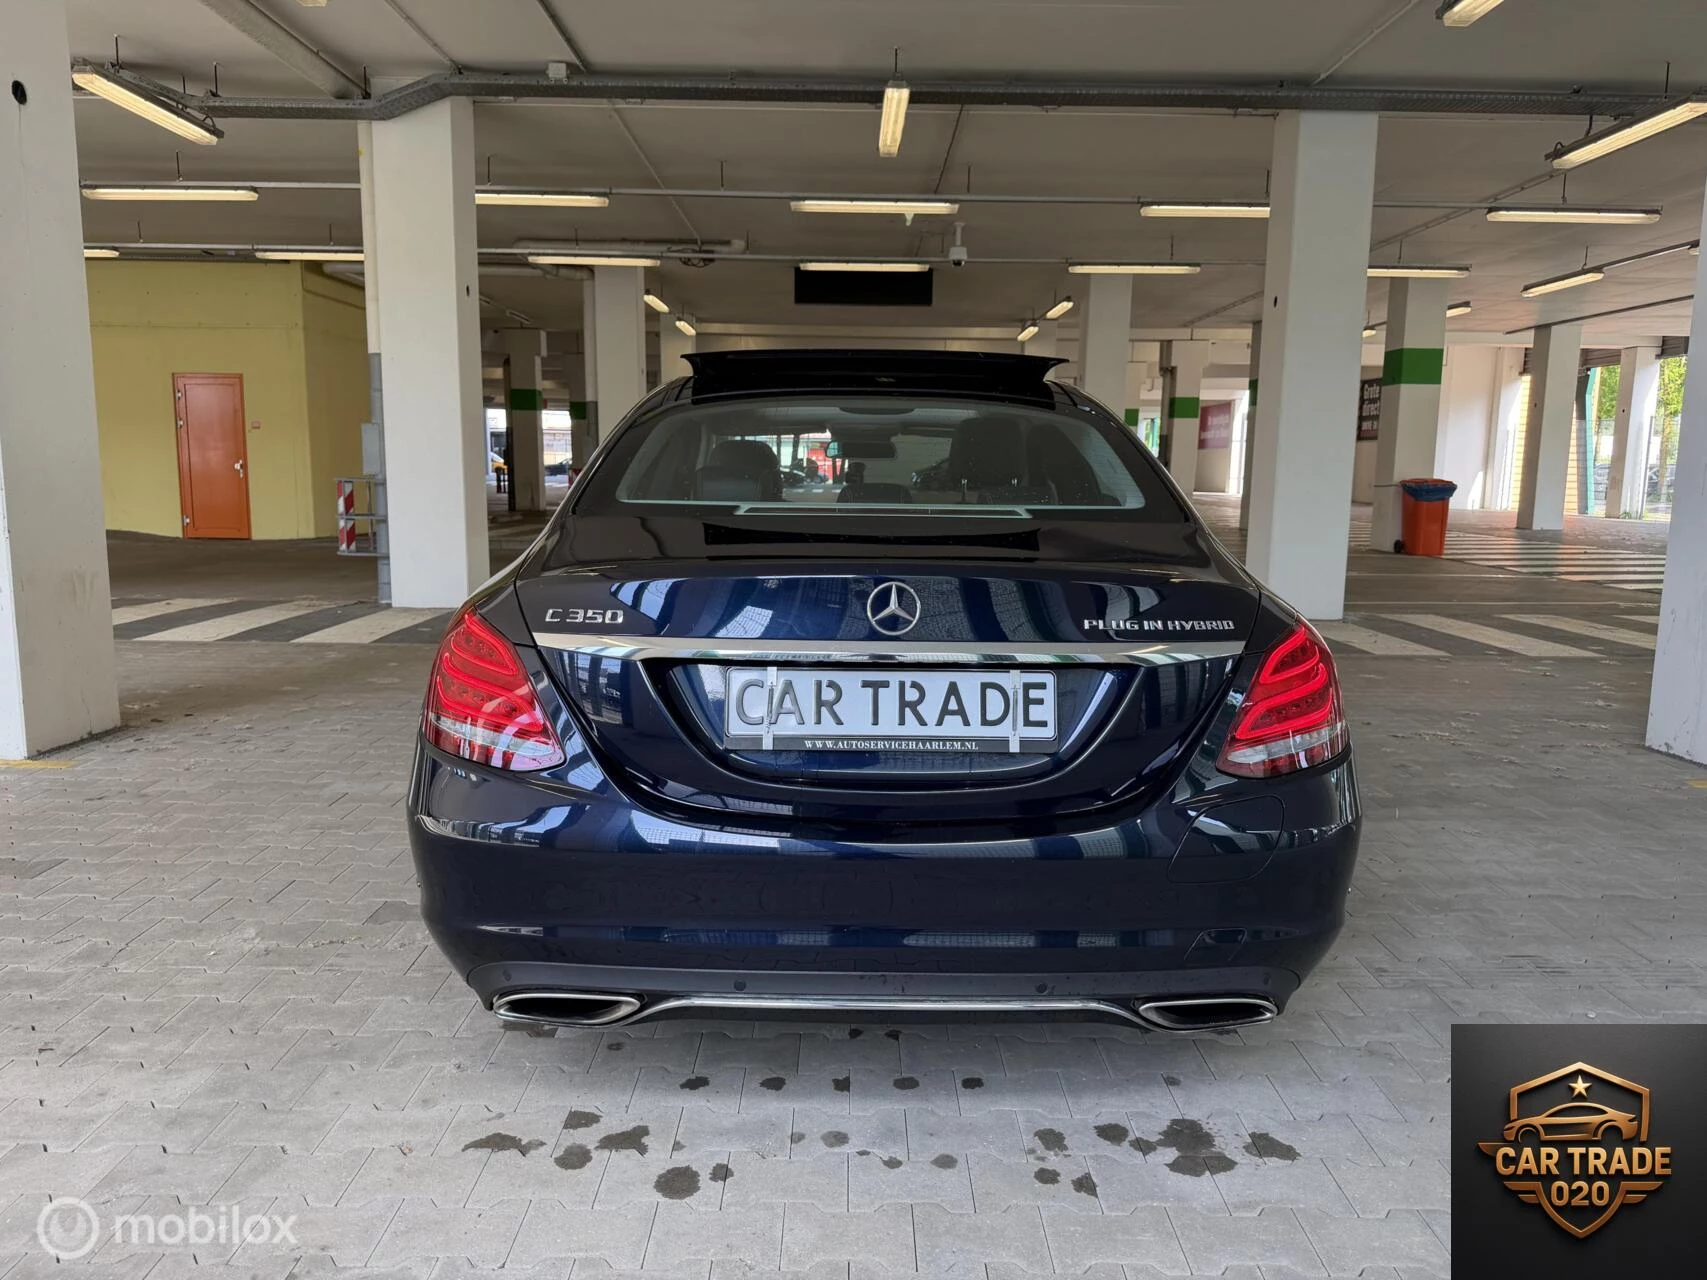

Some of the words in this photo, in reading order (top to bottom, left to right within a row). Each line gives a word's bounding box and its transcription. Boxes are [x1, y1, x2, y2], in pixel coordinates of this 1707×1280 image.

[545, 608, 563, 623] C
[565, 609, 624, 624] 350
[1083, 618, 1139, 631] PLUG
[1143, 619, 1163, 631] IN
[1167, 619, 1235, 631] HYBRID
[735, 679, 844, 726] CAR
[860, 679, 1048, 728] TRADE
[804, 739, 979, 751] WWW.AUTOSERVICEHAARLEM.NL
